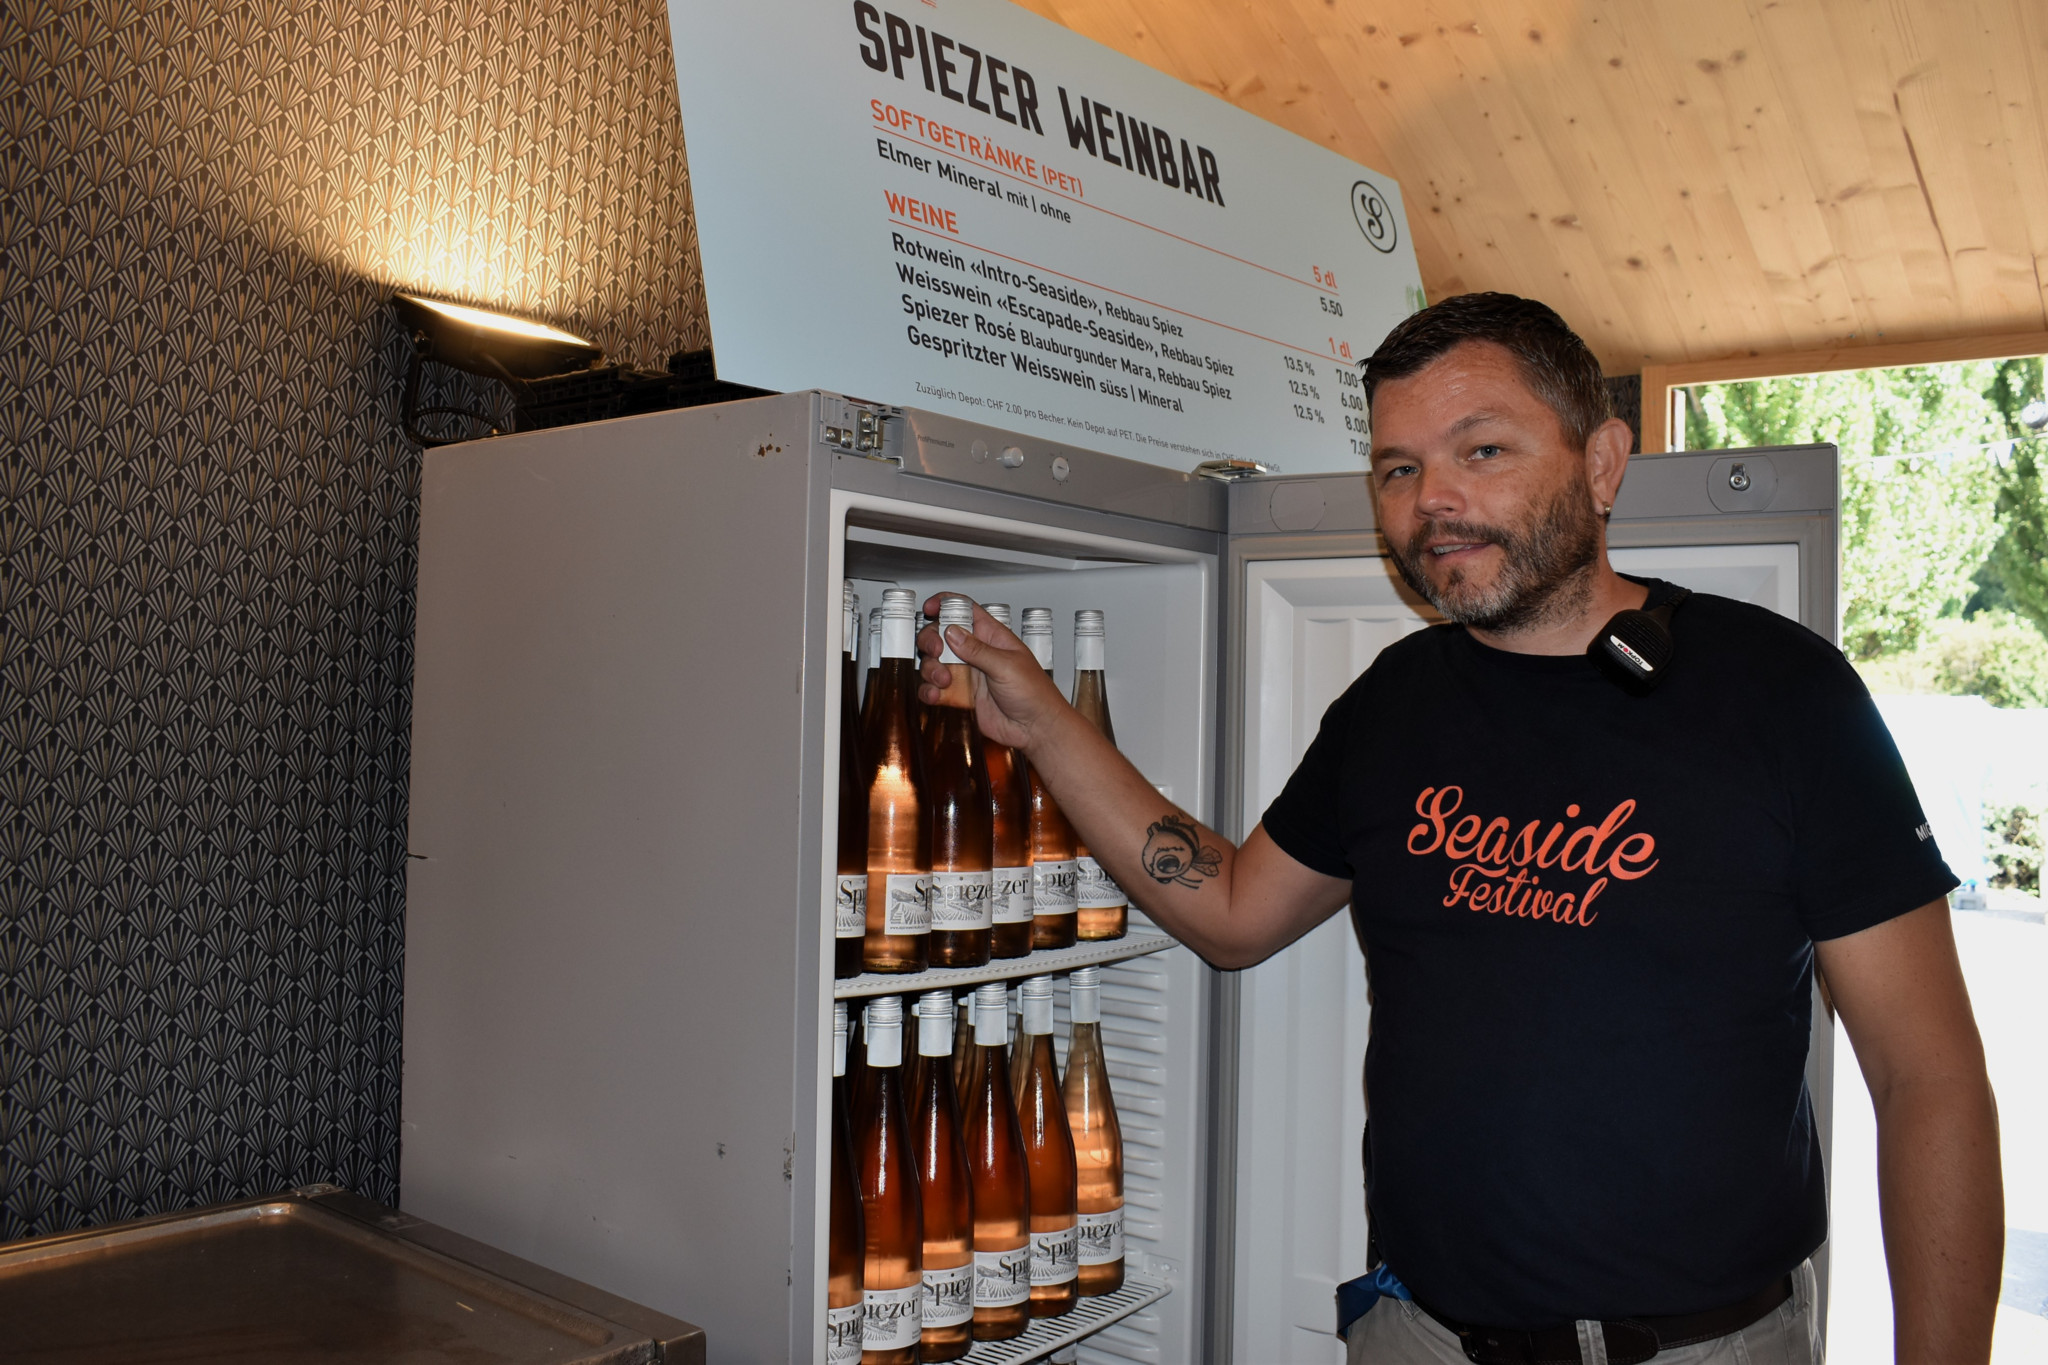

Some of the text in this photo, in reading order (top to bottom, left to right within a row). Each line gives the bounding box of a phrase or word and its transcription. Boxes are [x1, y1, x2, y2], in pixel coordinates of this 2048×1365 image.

[854, 0, 1226, 208] SPIEZER WEINBAR
[870, 98, 1084, 198] SOFTGETRÄNKE (PET)
[876, 138, 932, 175] Elmer
[939, 163, 1003, 200] Mineral
[1006, 188, 1030, 210] mit
[1040, 203, 1072, 224] ohne
[884, 189, 960, 235] WEINE
[891, 231, 966, 272] Rotwein
[1105, 302, 1151, 329] Rebbau
[1152, 315, 1184, 339] Spiez
[1312, 265, 1338, 290] 5 dl
[1319, 296, 1344, 318] 5.50
[896, 261, 992, 308] Weisswein
[1161, 344, 1204, 370] Rebbau
[1204, 355, 1235, 378] Spiez
[901, 293, 1232, 401] Spiezer Rosé Blauburgunder Mara, Rebbau Spiez
[1328, 336, 1353, 360] 1 dl
[907, 324, 1007, 369] Gespritzter
[1011, 350, 1096, 391] Weisswein
[1099, 378, 1129, 400] süss
[1138, 388, 1184, 414] Mineral
[1283, 355, 1358, 389] 13.5 % 7.00
[1288, 379, 1363, 412] 12.5 % 6.00
[915, 381, 957, 401] Zuzüglich
[958, 391, 986, 407] Depot:
[986, 398, 1004, 411] CHF
[1005, 402, 1022, 416] 2.00
[1023, 409, 1037, 419] pro
[1038, 410, 1066, 426] Becher.
[1067, 417, 1084, 430] Kein
[1085, 420, 1106, 435] Depot
[1107, 427, 1118, 436] auf
[1119, 428, 1135, 442] PET.
[1135, 433, 1147, 445] Die
[1147, 435, 1169, 449] Preise
[1170, 441, 1201, 456] verstehen
[1293, 403, 1368, 435] 12.5 % 8.00
[1407, 785, 1659, 880] Seaside
[1442, 863, 1609, 926] Festival
